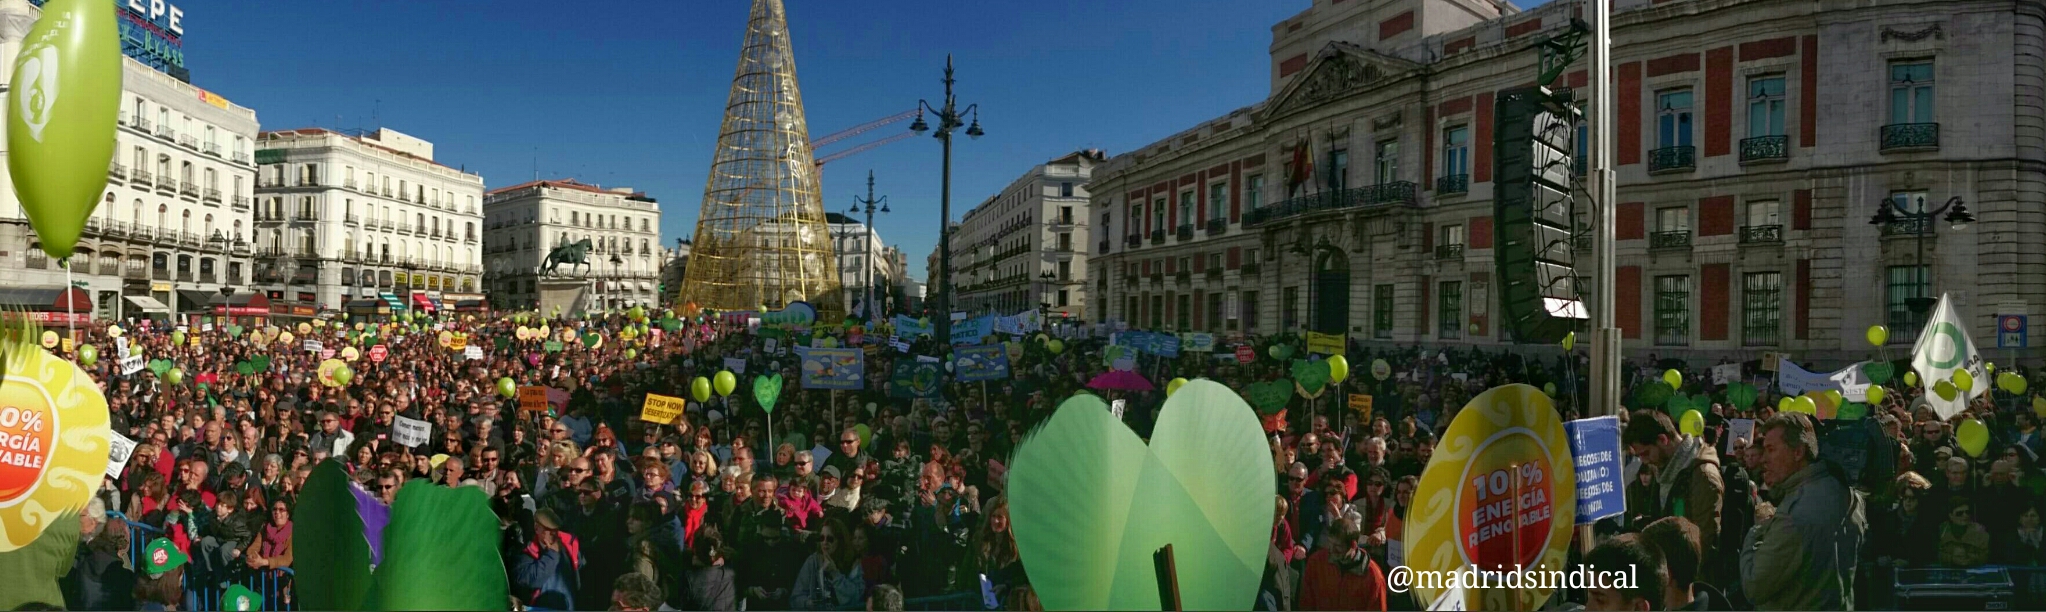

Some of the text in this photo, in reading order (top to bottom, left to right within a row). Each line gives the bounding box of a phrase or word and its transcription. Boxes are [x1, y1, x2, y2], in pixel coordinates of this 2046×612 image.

[647, 398, 682, 411] STOP NOW
[1468, 504, 1550, 549] RENOABLE
[1472, 487, 1547, 528] ENEGÍA
